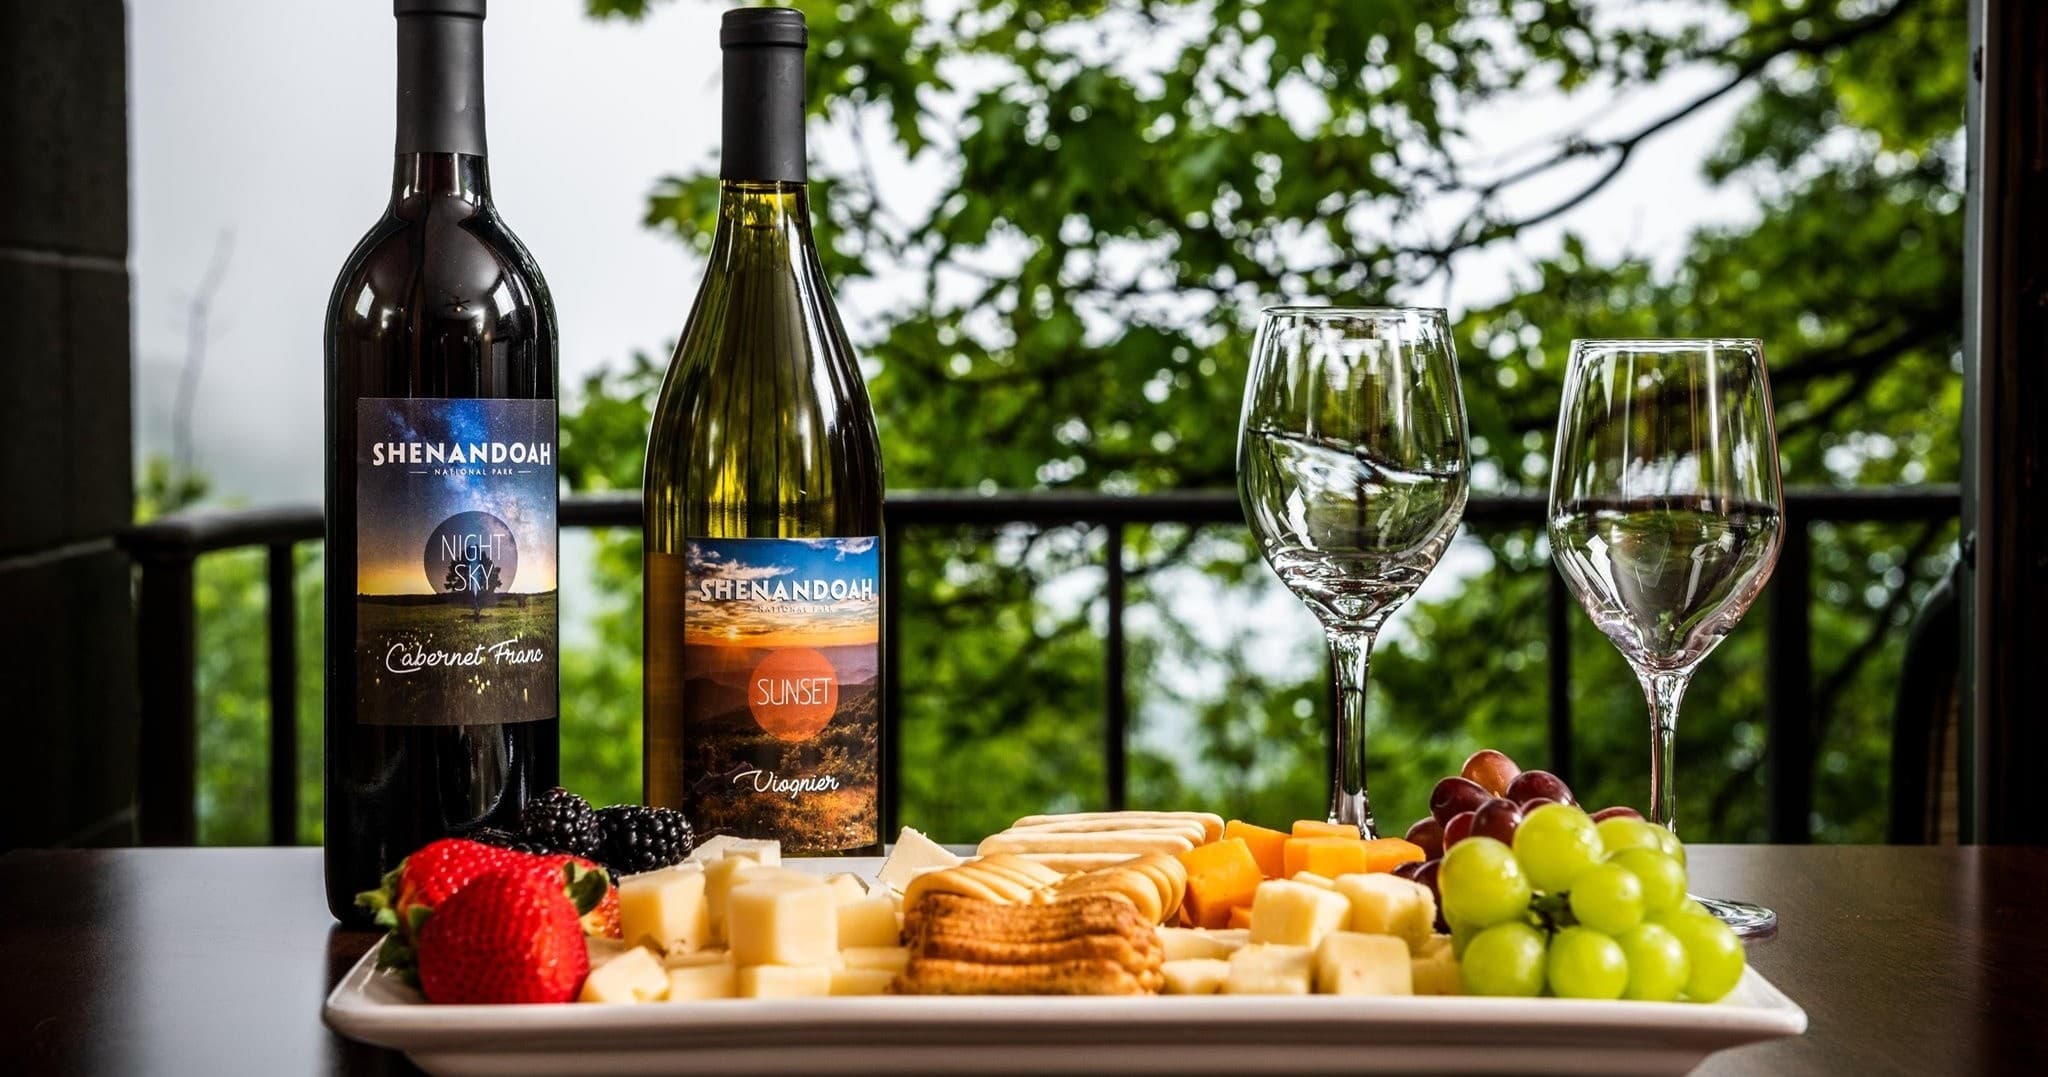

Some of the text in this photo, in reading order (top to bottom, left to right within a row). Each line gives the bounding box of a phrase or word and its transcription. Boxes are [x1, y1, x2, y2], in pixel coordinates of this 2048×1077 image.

[373, 442, 551, 465] SHENANDOAH
[434, 468, 513, 476] NATIONAL PARK
[441, 534, 506, 562] NIGHT
[454, 563, 494, 592] SKY
[700, 578, 873, 601] SHENANDOAH
[386, 638, 543, 673] Cabernet Franc
[757, 678, 832, 705] SUNSET
[733, 770, 839, 799] Viognier
